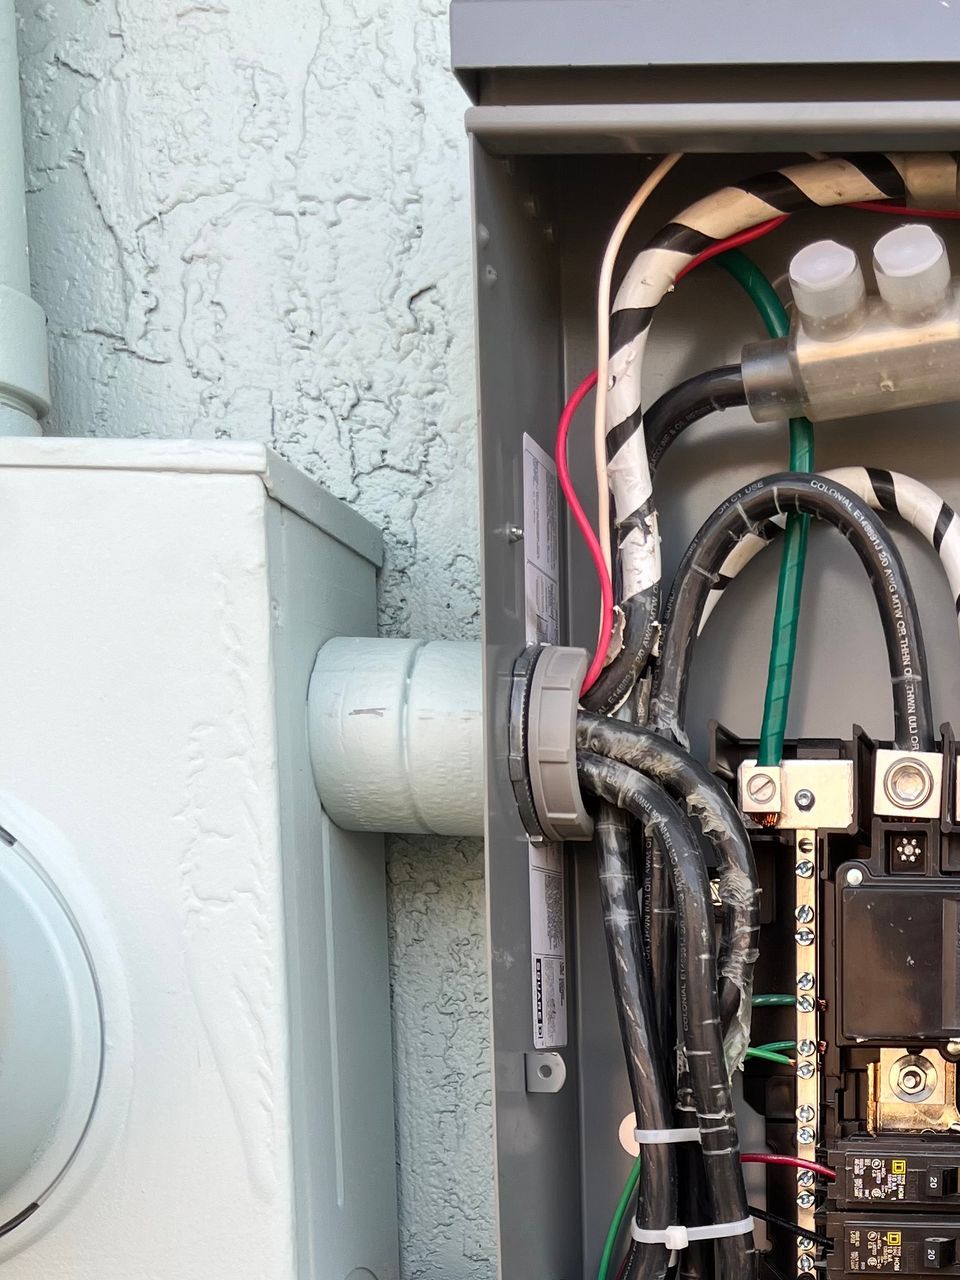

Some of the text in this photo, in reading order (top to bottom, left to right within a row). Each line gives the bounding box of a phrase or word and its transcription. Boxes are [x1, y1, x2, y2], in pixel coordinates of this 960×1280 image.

[810, 479, 853, 512] COLONIAL
[929, 1176, 937, 1189] 20
[927, 1249, 936, 1260] 20
